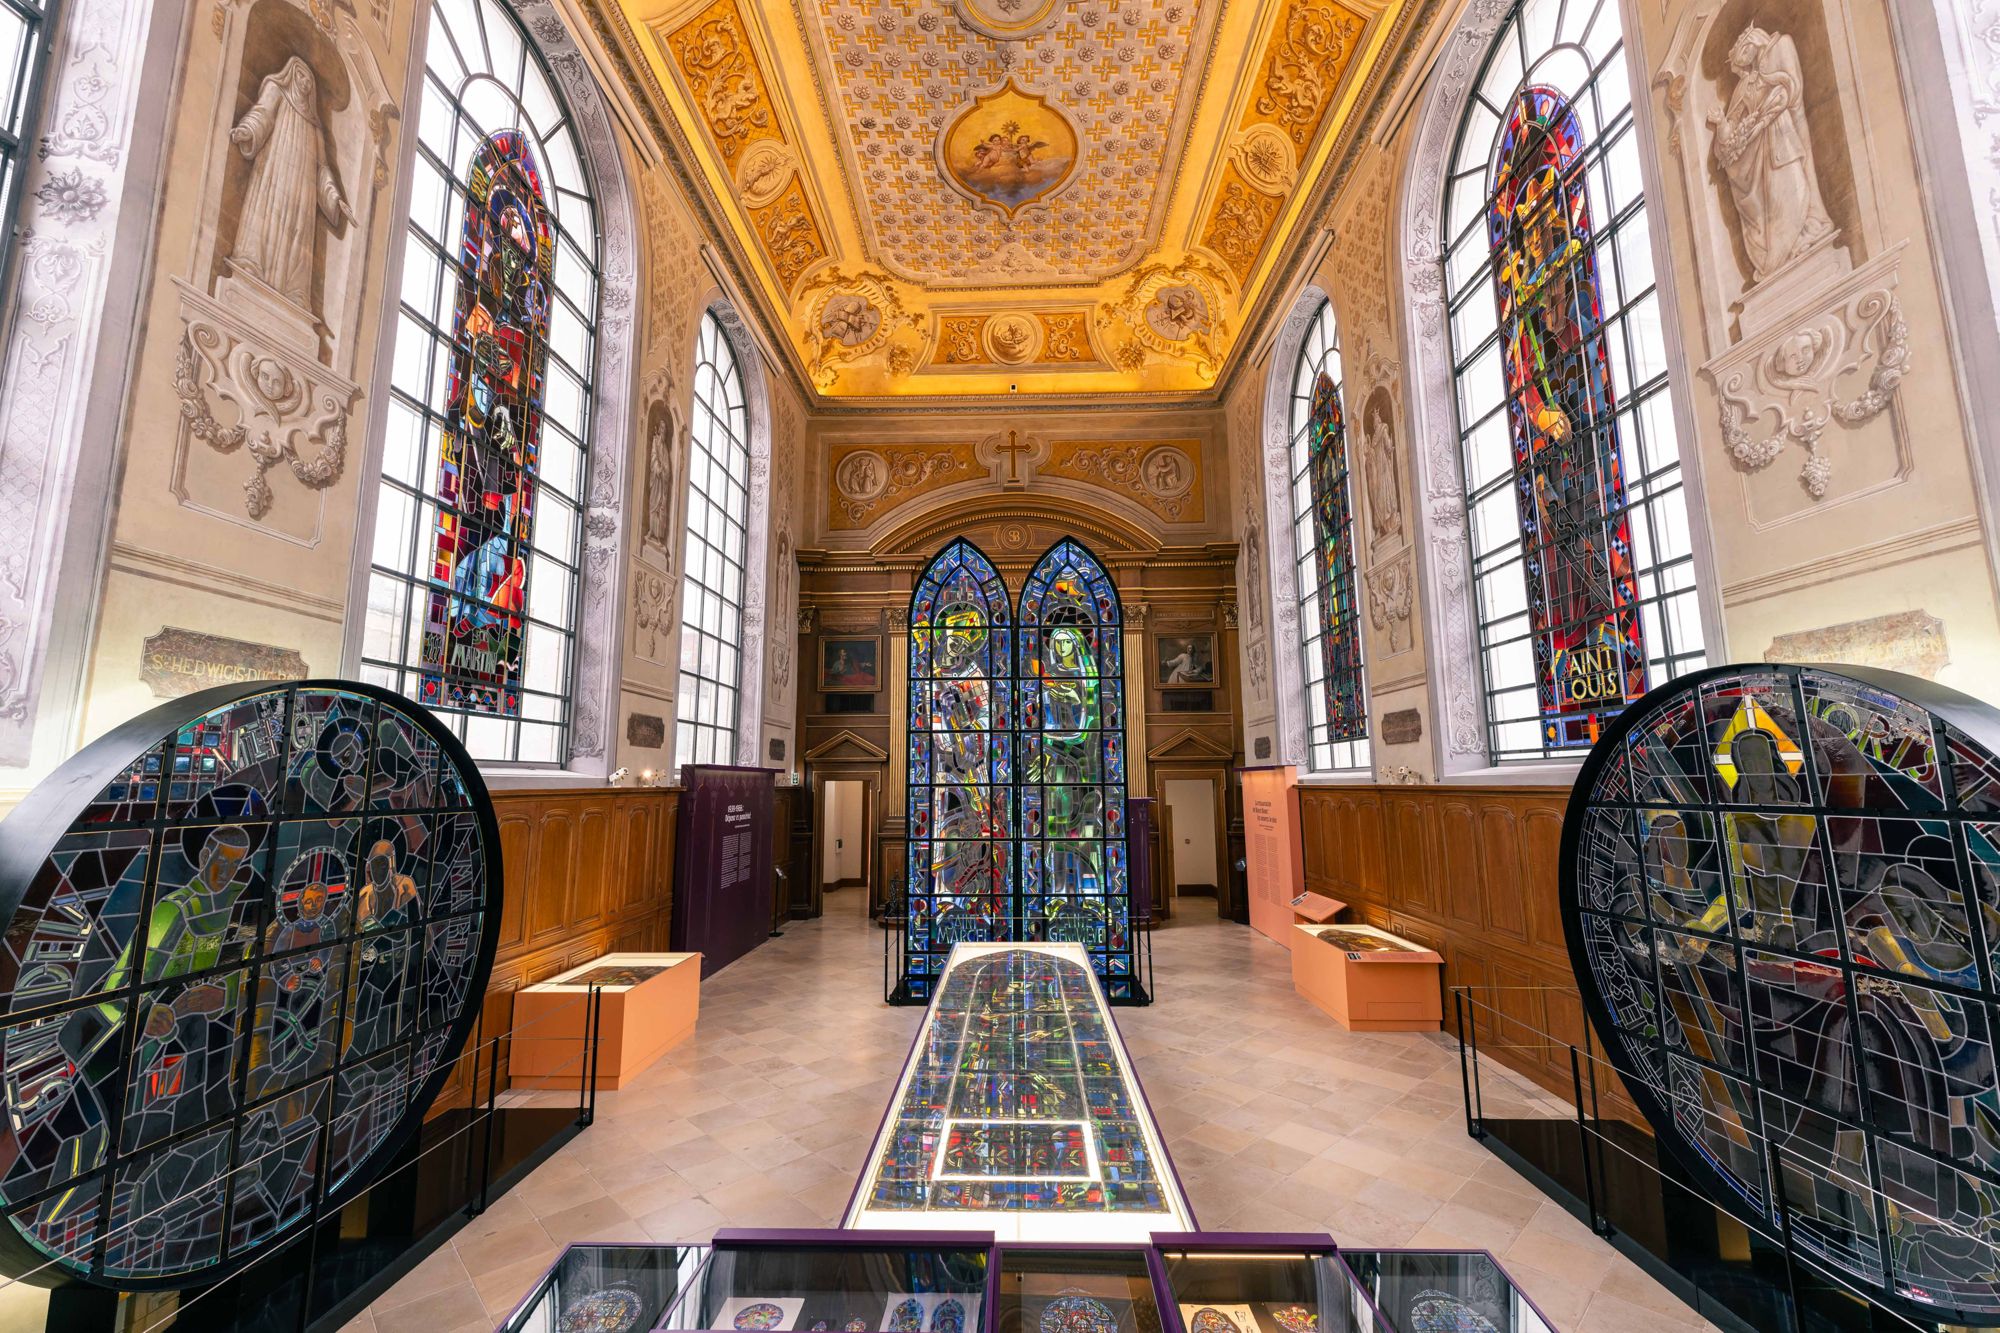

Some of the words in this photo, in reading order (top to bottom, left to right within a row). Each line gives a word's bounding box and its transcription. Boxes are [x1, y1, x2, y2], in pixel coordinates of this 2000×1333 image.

[450, 644, 497, 675] MARTIN
[1566, 648, 1613, 677] AINT
[1560, 671, 1617, 703] LOUIS
[947, 914, 976, 929] SAINT
